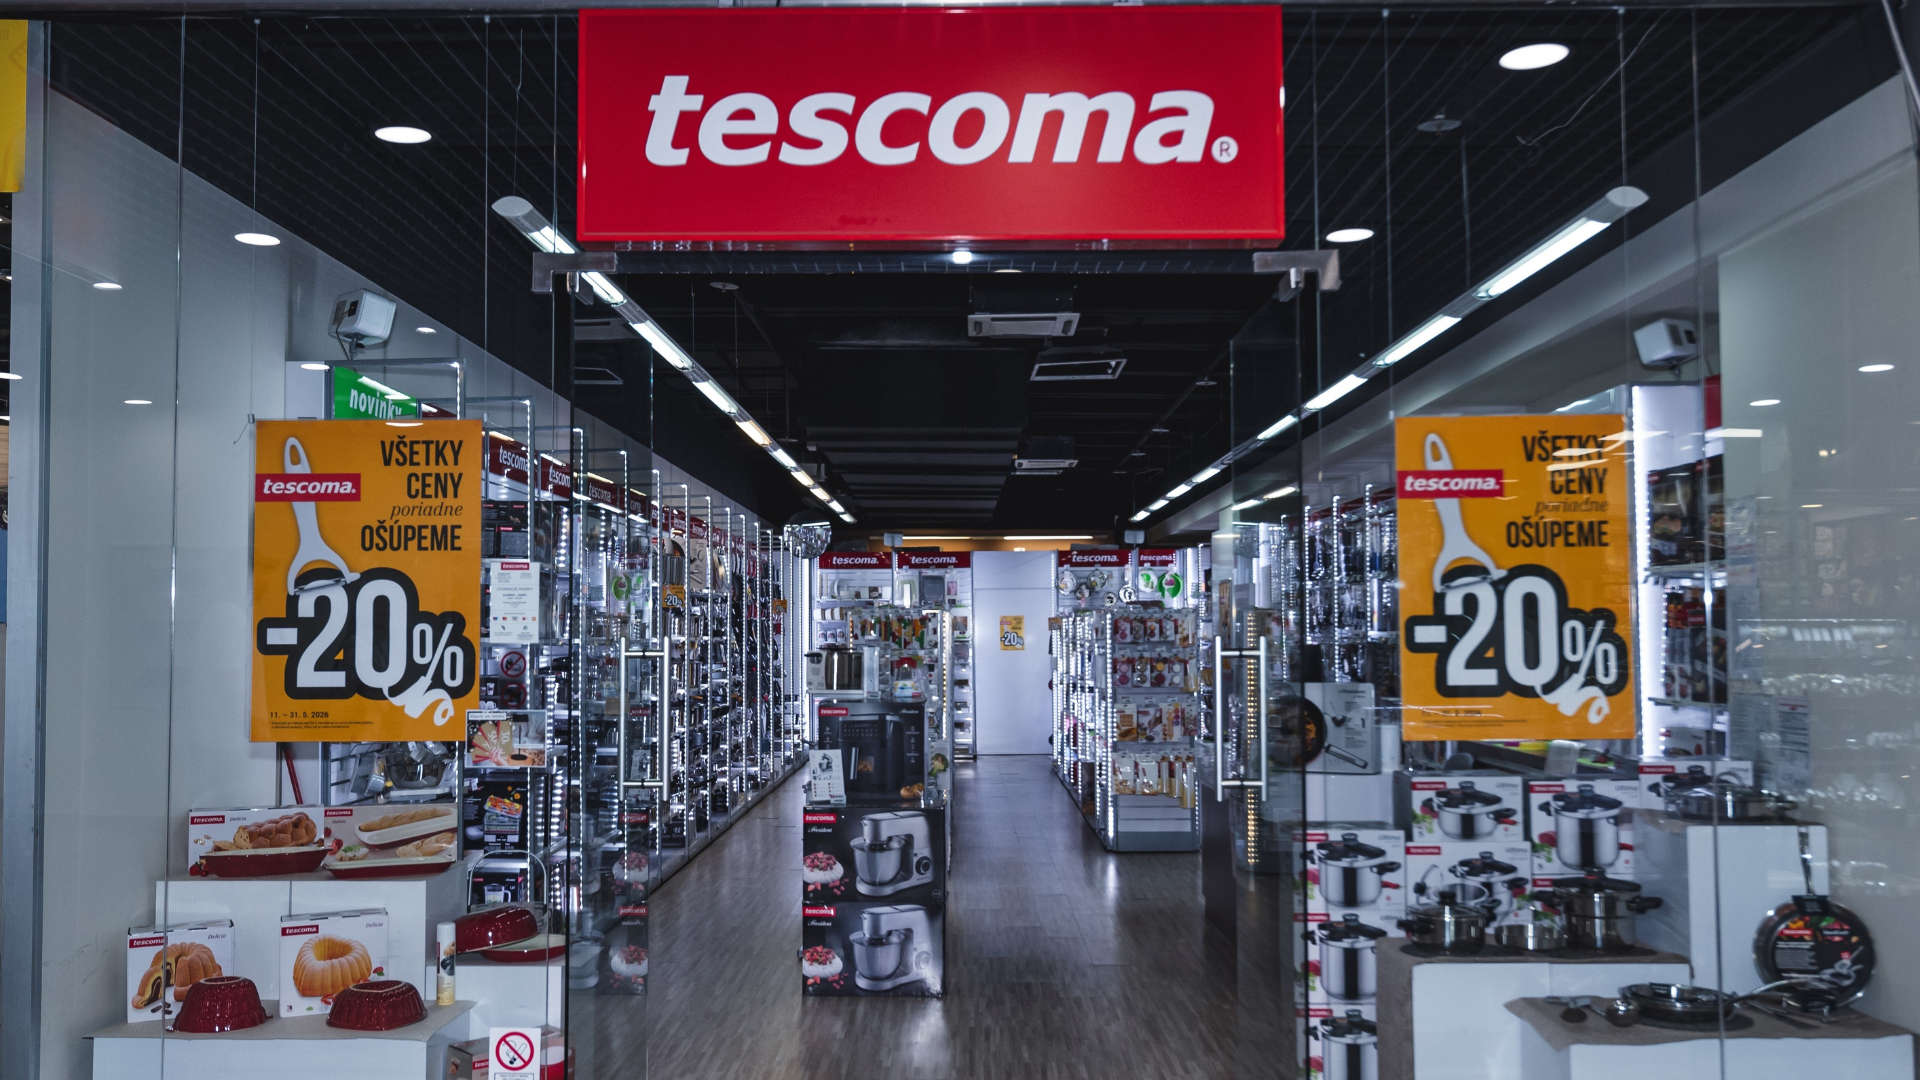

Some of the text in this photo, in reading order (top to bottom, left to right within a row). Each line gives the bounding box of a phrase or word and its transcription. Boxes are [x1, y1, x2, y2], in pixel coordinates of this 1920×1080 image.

[380, 435, 464, 467] VŠETKY
[1521, 430, 1607, 462] VŠETKY
[262, 478, 357, 495] tescoma.
[406, 472, 464, 499] CENY
[549, 465, 571, 488] tescom
[1404, 475, 1501, 492] tescoma.
[1550, 467, 1608, 495] CENY
[390, 502, 464, 521] poriadne
[1534, 496, 1609, 516] poriadne
[360, 519, 463, 551] OŠÚPEME
[1506, 516, 1610, 548] OŠÚPEME
[832, 555, 879, 565] tescoma.
[911, 555, 958, 564] tescoma.
[1071, 553, 1120, 563] tescoma.
[266, 579, 465, 689] -20%
[1413, 576, 1619, 687] -20%
[270, 711, 281, 719] 11.
[289, 711, 300, 719] 31.
[311, 711, 329, 719] 2026
